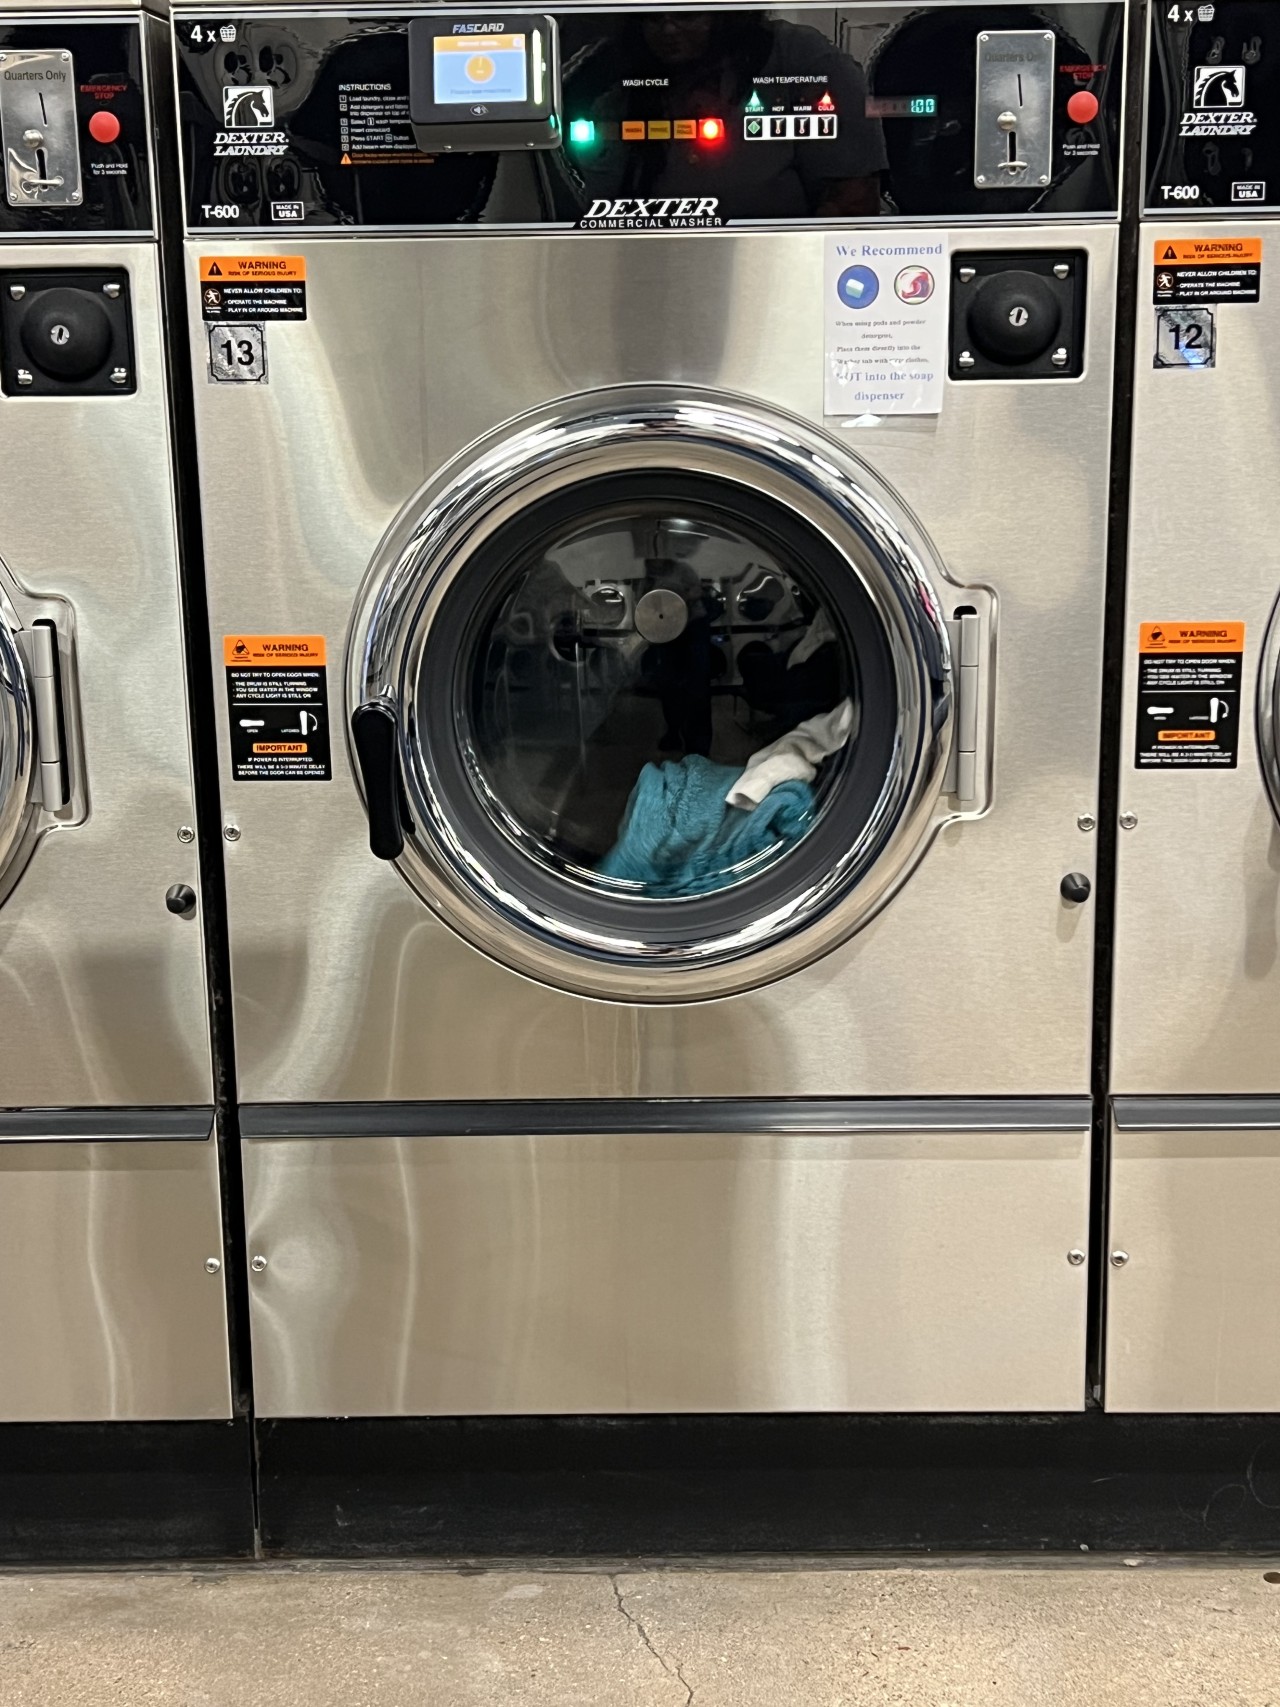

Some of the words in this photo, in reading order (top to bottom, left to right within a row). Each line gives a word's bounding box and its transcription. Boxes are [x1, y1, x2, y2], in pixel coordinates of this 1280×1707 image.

[1167, 4, 1180, 23] 4
[190, 25, 203, 43] 4
[452, 23, 505, 34] FASCARD
[4, 70, 45, 82] Quarters
[45, 70, 67, 83] Only
[775, 76, 828, 84] TEMPERATURE
[622, 79, 644, 87] WASH
[94, 92, 115, 100] STOP
[1180, 112, 1254, 125] DEXTER
[1179, 124, 1256, 136] LAUNDRY
[213, 132, 286, 144] DEXTER
[213, 145, 288, 156] LAUNDRY
[1161, 184, 1200, 200] T-600
[1239, 189, 1258, 199] USA
[202, 204, 240, 219] T-600
[583, 197, 719, 218] DEXTER
[278, 210, 298, 219] USA
[579, 219, 664, 229] COMMERCIAL
[669, 217, 722, 227] WASHER
[836, 245, 857, 257] We
[861, 243, 943, 257] Recommend
[1194, 243, 1243, 252] WARNING
[237, 261, 287, 270] WARNING
[872, 319, 888, 327] pods
[902, 319, 926, 327] powder
[1169, 323, 1203, 350] 12
[220, 339, 255, 367] 13
[865, 372, 888, 382] into
[889, 371, 907, 381] the
[908, 372, 934, 383] soap
[854, 391, 905, 403] dispenser
[1179, 630, 1228, 638] WARNING
[262, 643, 309, 652] WARNING
[1163, 732, 1211, 740] IMPORTANT
[256, 744, 303, 752] IMPORTANT
